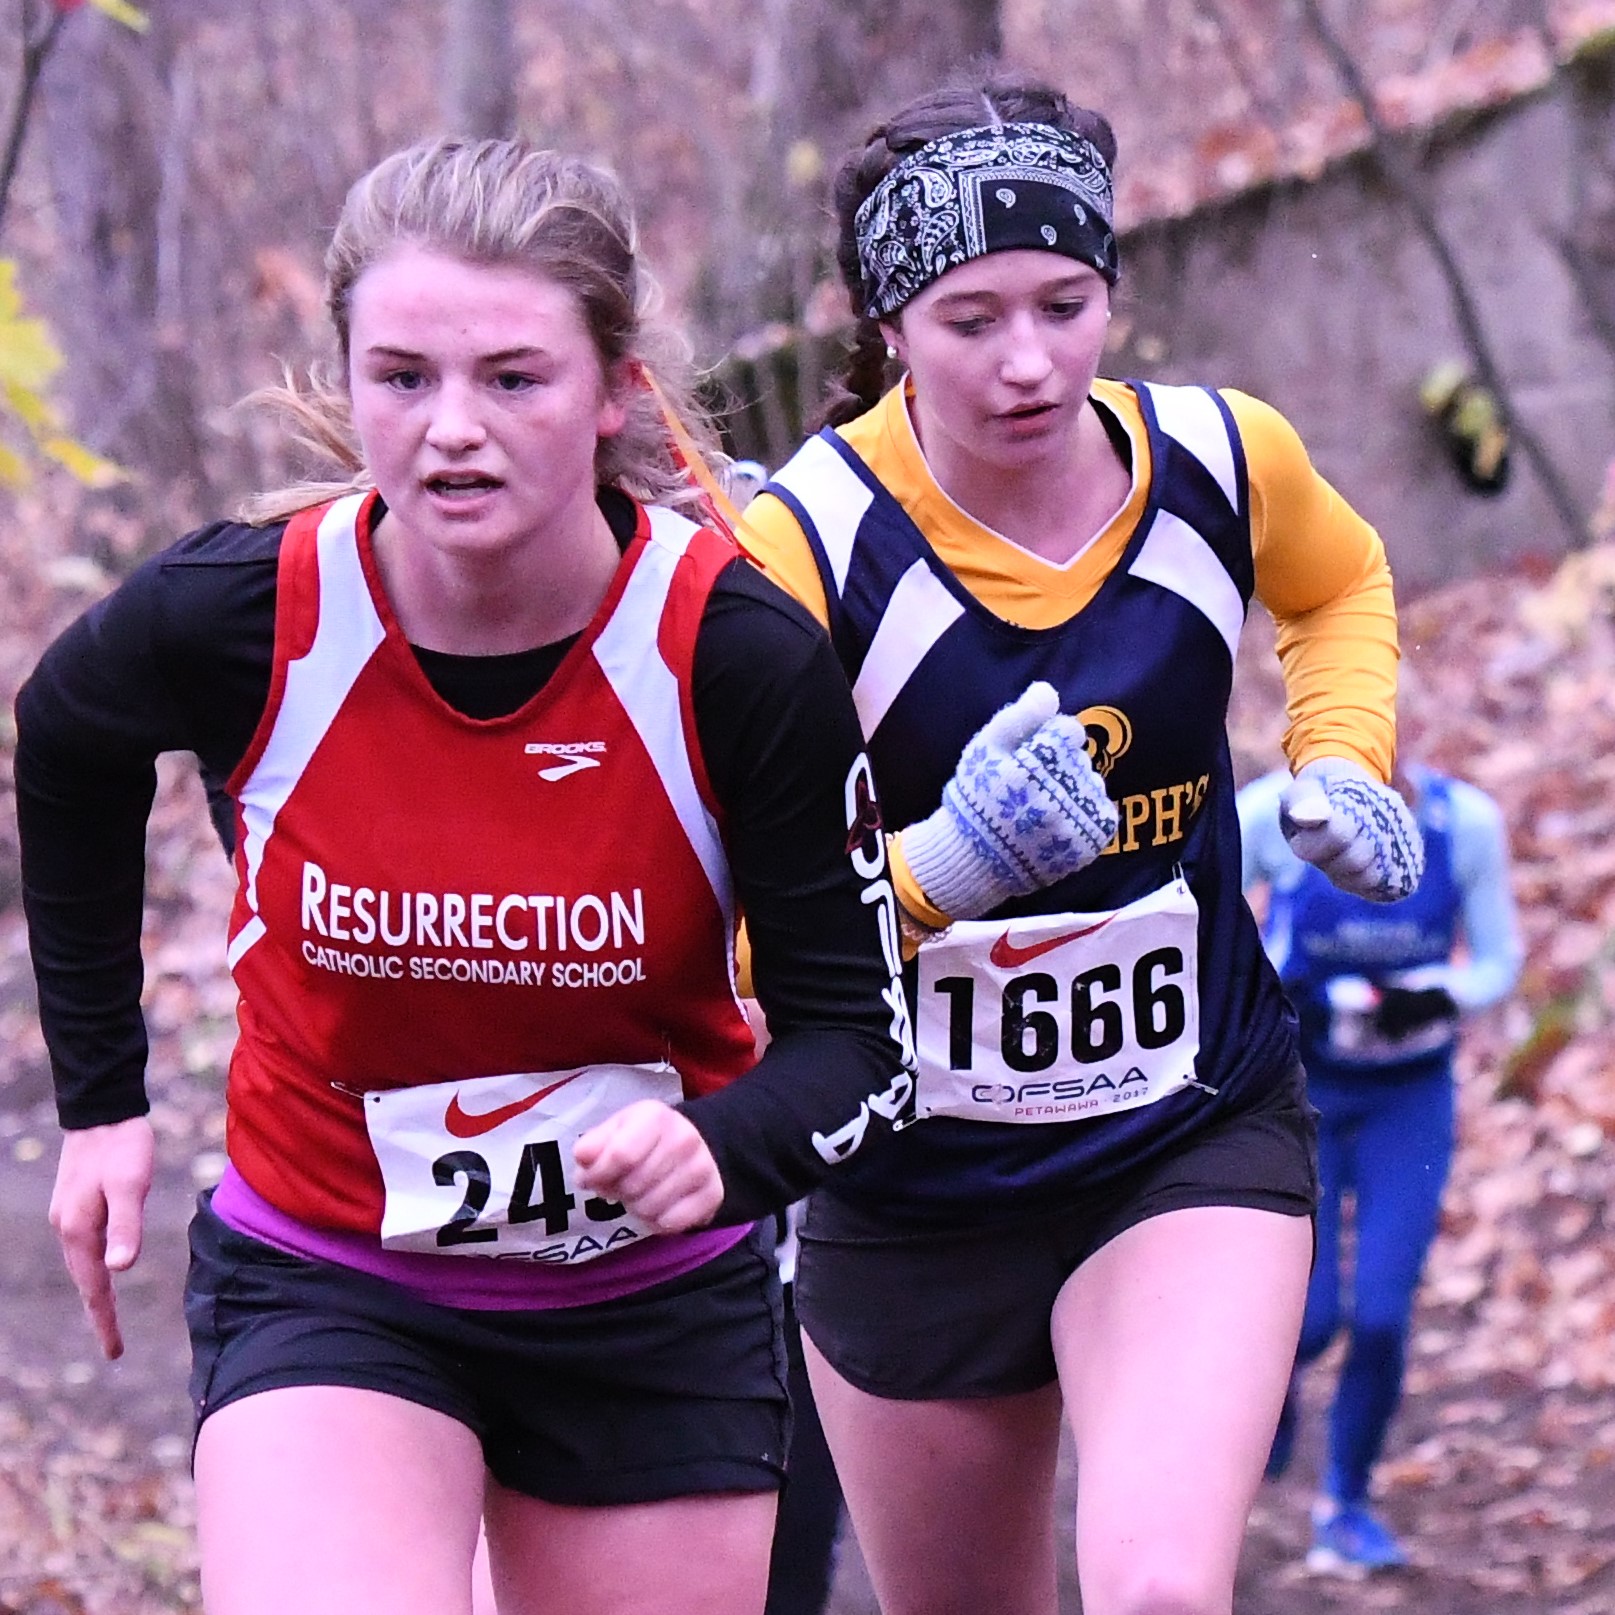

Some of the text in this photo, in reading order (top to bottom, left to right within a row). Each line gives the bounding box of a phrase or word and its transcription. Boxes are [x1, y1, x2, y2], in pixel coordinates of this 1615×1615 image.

[524, 741, 607, 755] BROOKS
[301, 861, 646, 952] RESURRECTION
[302, 940, 647, 989] CATHOLIC SECONDARY SCHOOL
[933, 946, 1186, 1073] 1666
[971, 1066, 1149, 1104] OFSAA
[1014, 1087, 1149, 1117] PETAWAWA 2017
[478, 1226, 639, 1264] FSAA
